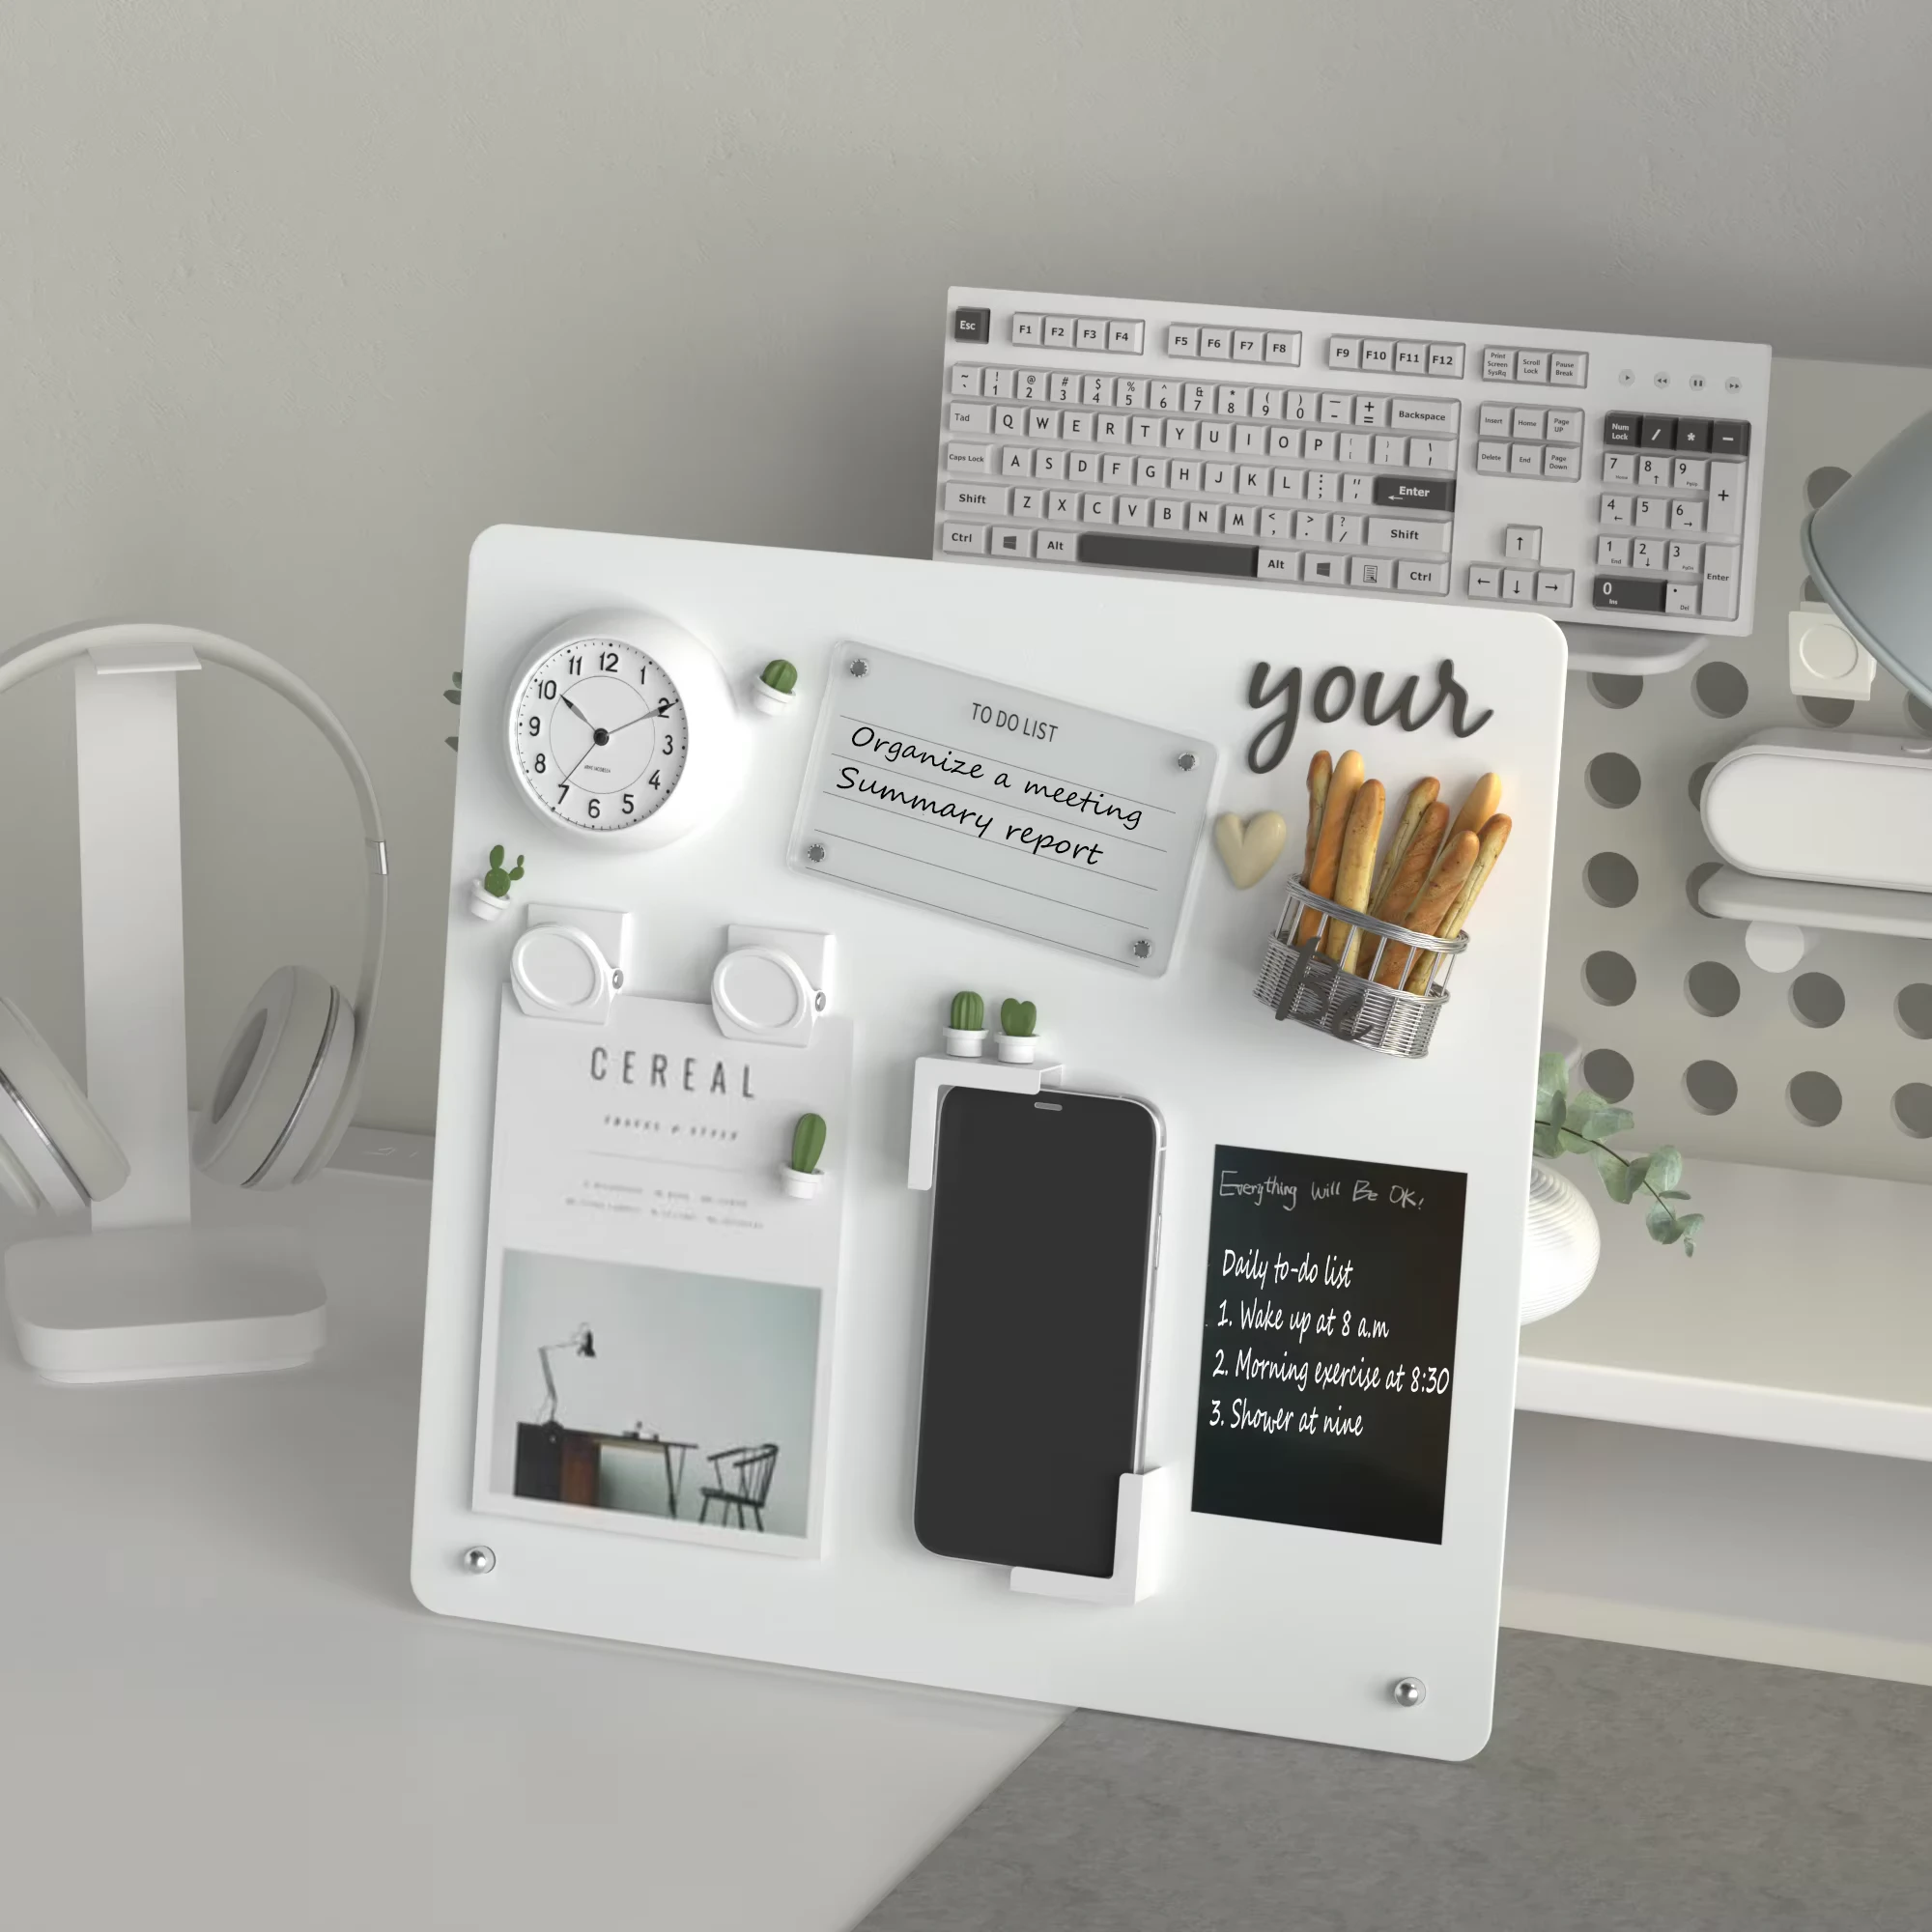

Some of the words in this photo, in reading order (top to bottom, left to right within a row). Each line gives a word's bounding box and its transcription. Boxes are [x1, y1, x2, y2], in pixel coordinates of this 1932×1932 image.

[960, 321, 975, 329] Esc
[1052, 327, 1064, 336] F2
[1116, 332, 1128, 341] F4
[1208, 339, 1220, 348] F6
[1273, 344, 1286, 353] F8
[1337, 349, 1350, 357] F9
[1367, 351, 1386, 360] F10
[1400, 354, 1419, 362] F11
[1433, 355, 1452, 365] F12
[1488, 369, 1507, 378] SysRq
[1093, 393, 1099, 403] 4
[1160, 398, 1167, 408] 6
[1228, 403, 1235, 413] 8
[1263, 406, 1269, 415] 9
[1004, 414, 1013, 429] Q
[1399, 411, 1445, 420] Backspace
[1037, 417, 1049, 429] W
[1073, 420, 1080, 432] E
[1106, 423, 1114, 435] R
[1141, 425, 1150, 437] T
[1176, 428, 1184, 440] Y
[1210, 431, 1218, 442] U
[1315, 439, 1322, 450] P
[1011, 455, 1019, 467] A
[1079, 460, 1087, 471] D
[1610, 458, 1617, 469] 7
[1113, 463, 1121, 474] F
[1146, 466, 1154, 477] G
[1180, 469, 1188, 480] H
[1215, 471, 1222, 483] J
[1248, 474, 1256, 486] K
[1283, 476, 1290, 489] L
[1399, 486, 1430, 497] Enter
[959, 494, 985, 503] Shift
[1024, 497, 1031, 508] Z
[1607, 499, 1614, 510] 4
[1058, 499, 1066, 511] X
[1094, 502, 1100, 514] C
[1128, 505, 1137, 517] V
[1164, 508, 1171, 520] B
[1199, 511, 1208, 523] N
[1233, 514, 1243, 526] M
[952, 533, 972, 542] Ctrl
[1391, 529, 1418, 540] Shift
[1047, 541, 1063, 550] Alt
[1639, 544, 1646, 554] 2
[1673, 546, 1680, 556] 3
[1268, 560, 1284, 569] Alt
[1410, 572, 1431, 581] Ctrl
[1604, 582, 1611, 595] 0
[569, 656, 582, 675] 11
[600, 652, 618, 672] 12
[538, 679, 557, 699] 10
[657, 697, 670, 718] 2
[973, 703, 992, 724] TO
[996, 710, 1018, 731] DO
[1023, 718, 1058, 742] LIST
[1248, 659, 1494, 774] your
[529, 717, 540, 736] 9
[663, 735, 673, 755] 3
[534, 753, 546, 774] 8
[648, 770, 660, 790] 4
[849, 726, 983, 781] Organize
[994, 774, 1010, 787] a
[1023, 781, 1142, 833] meeting
[558, 782, 569, 804] 7
[588, 799, 600, 818] 6
[622, 794, 634, 814] 5
[836, 767, 994, 838] Summary
[1005, 822, 1104, 865] report
[590, 1046, 755, 1099] CEREAL
[1220, 1171, 1297, 1210] Everything
[1352, 1180, 1378, 1202] Be
[1223, 1249, 1268, 1290] Daily
[1274, 1252, 1318, 1283] to-do
[1324, 1255, 1353, 1289] list
[1218, 1299, 1232, 1326] 1.
[1241, 1297, 1283, 1330] Wake
[1290, 1312, 1311, 1344] up
[1317, 1308, 1336, 1336] at
[1342, 1310, 1351, 1336] 8
[1358, 1318, 1389, 1338] a.m
[1213, 1350, 1228, 1377] 2.
[1236, 1348, 1308, 1391] Morning
[1315, 1357, 1380, 1391] exercise
[1385, 1364, 1406, 1392] at
[1411, 1366, 1449, 1394] 8:30
[1209, 1400, 1224, 1426] 3.
[1231, 1398, 1293, 1434] Shower
[1299, 1406, 1319, 1435] at
[1323, 1406, 1363, 1436] nine
